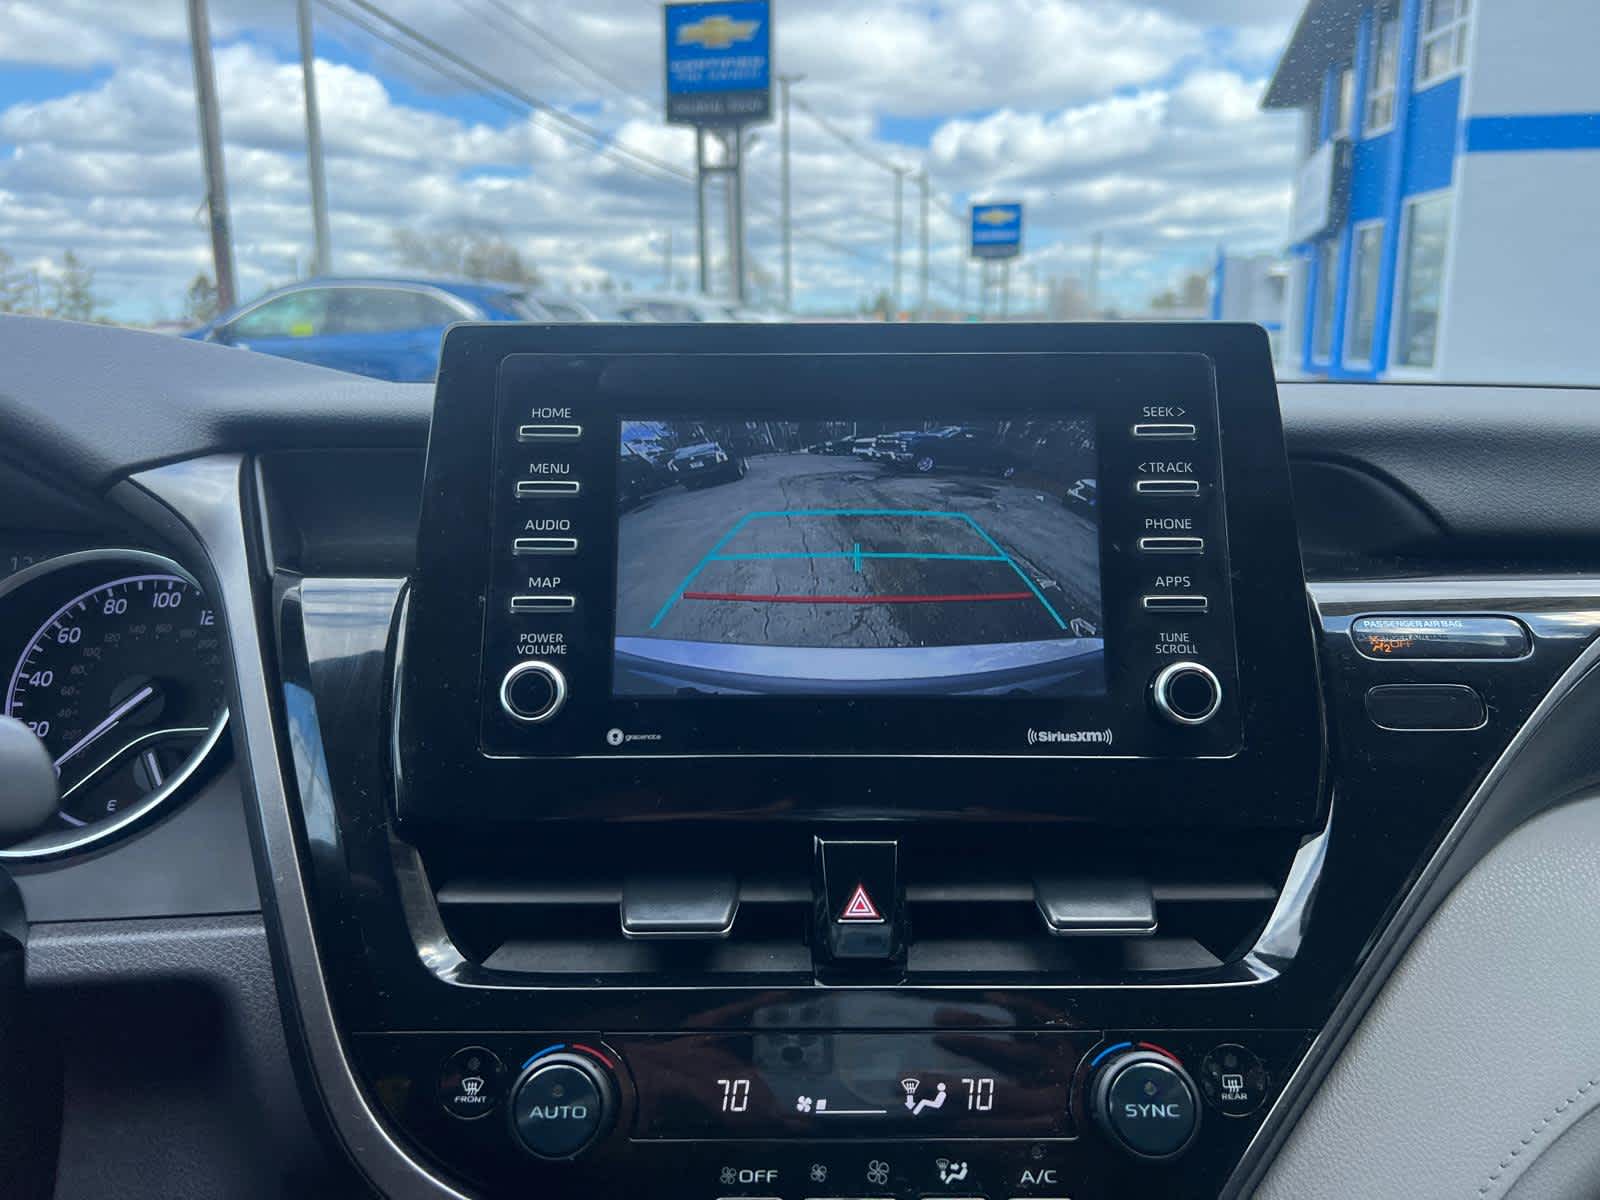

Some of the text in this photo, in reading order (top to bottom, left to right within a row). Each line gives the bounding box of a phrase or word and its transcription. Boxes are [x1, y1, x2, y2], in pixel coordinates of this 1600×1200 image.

[531, 407, 572, 419] HOME
[1143, 406, 1174, 417] SEEK
[529, 463, 570, 474] MENU
[1150, 462, 1193, 473] TRACK
[524, 519, 571, 531] AUDIO
[1145, 518, 1193, 530] PHONE
[528, 577, 561, 588] MAP
[1155, 576, 1191, 588] APPS
[152, 592, 182, 608] 100
[104, 599, 127, 614] 80
[57, 627, 81, 643] 60
[520, 633, 564, 644] POWER
[1159, 632, 1190, 643] TUNE
[516, 644, 568, 655] VOLUME
[1155, 643, 1199, 655] SCROLL
[1391, 640, 1414, 648] OFF
[29, 671, 53, 687] 40
[453, 1094, 487, 1104] FRONT
[717, 1079, 750, 1112] 70
[961, 1078, 995, 1112] 70
[1221, 1092, 1248, 1101] REAR
[529, 1105, 587, 1120] AUTO
[1124, 1103, 1181, 1119] SYNC
[738, 1169, 778, 1184] OFF
[1019, 1169, 1058, 1185] A/C
